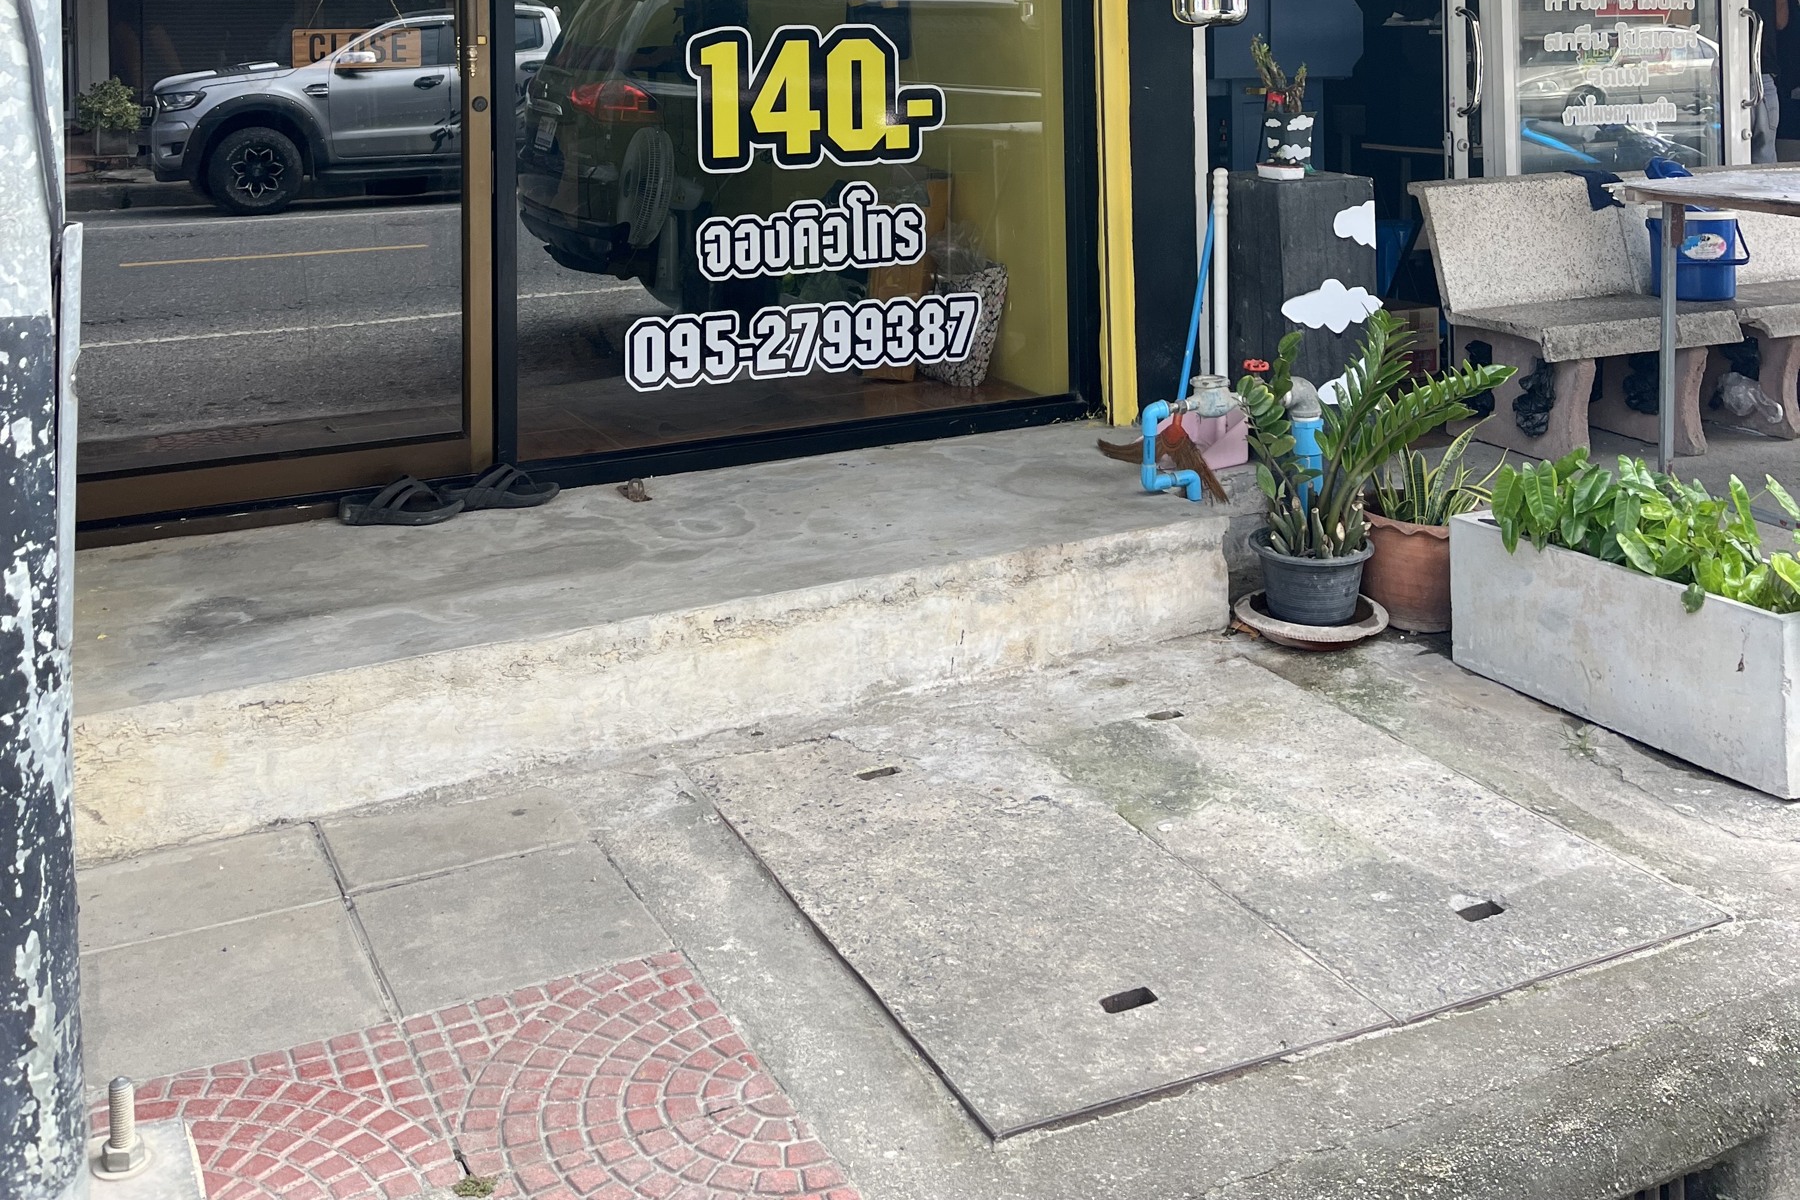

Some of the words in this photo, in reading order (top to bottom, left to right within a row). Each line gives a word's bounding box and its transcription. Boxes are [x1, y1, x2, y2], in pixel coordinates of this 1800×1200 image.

[1544, 24, 1609, 51] สกรีน
[1615, 22, 1701, 49] โปสเตอร์
[695, 33, 938, 164] 140.-
[1587, 61, 1650, 87] รถแห่
[1562, 95, 1677, 131] งานโฆษณาทุกชนิด
[701, 186, 924, 276] จองคิวโทร
[630, 297, 979, 387] 095-2799387
